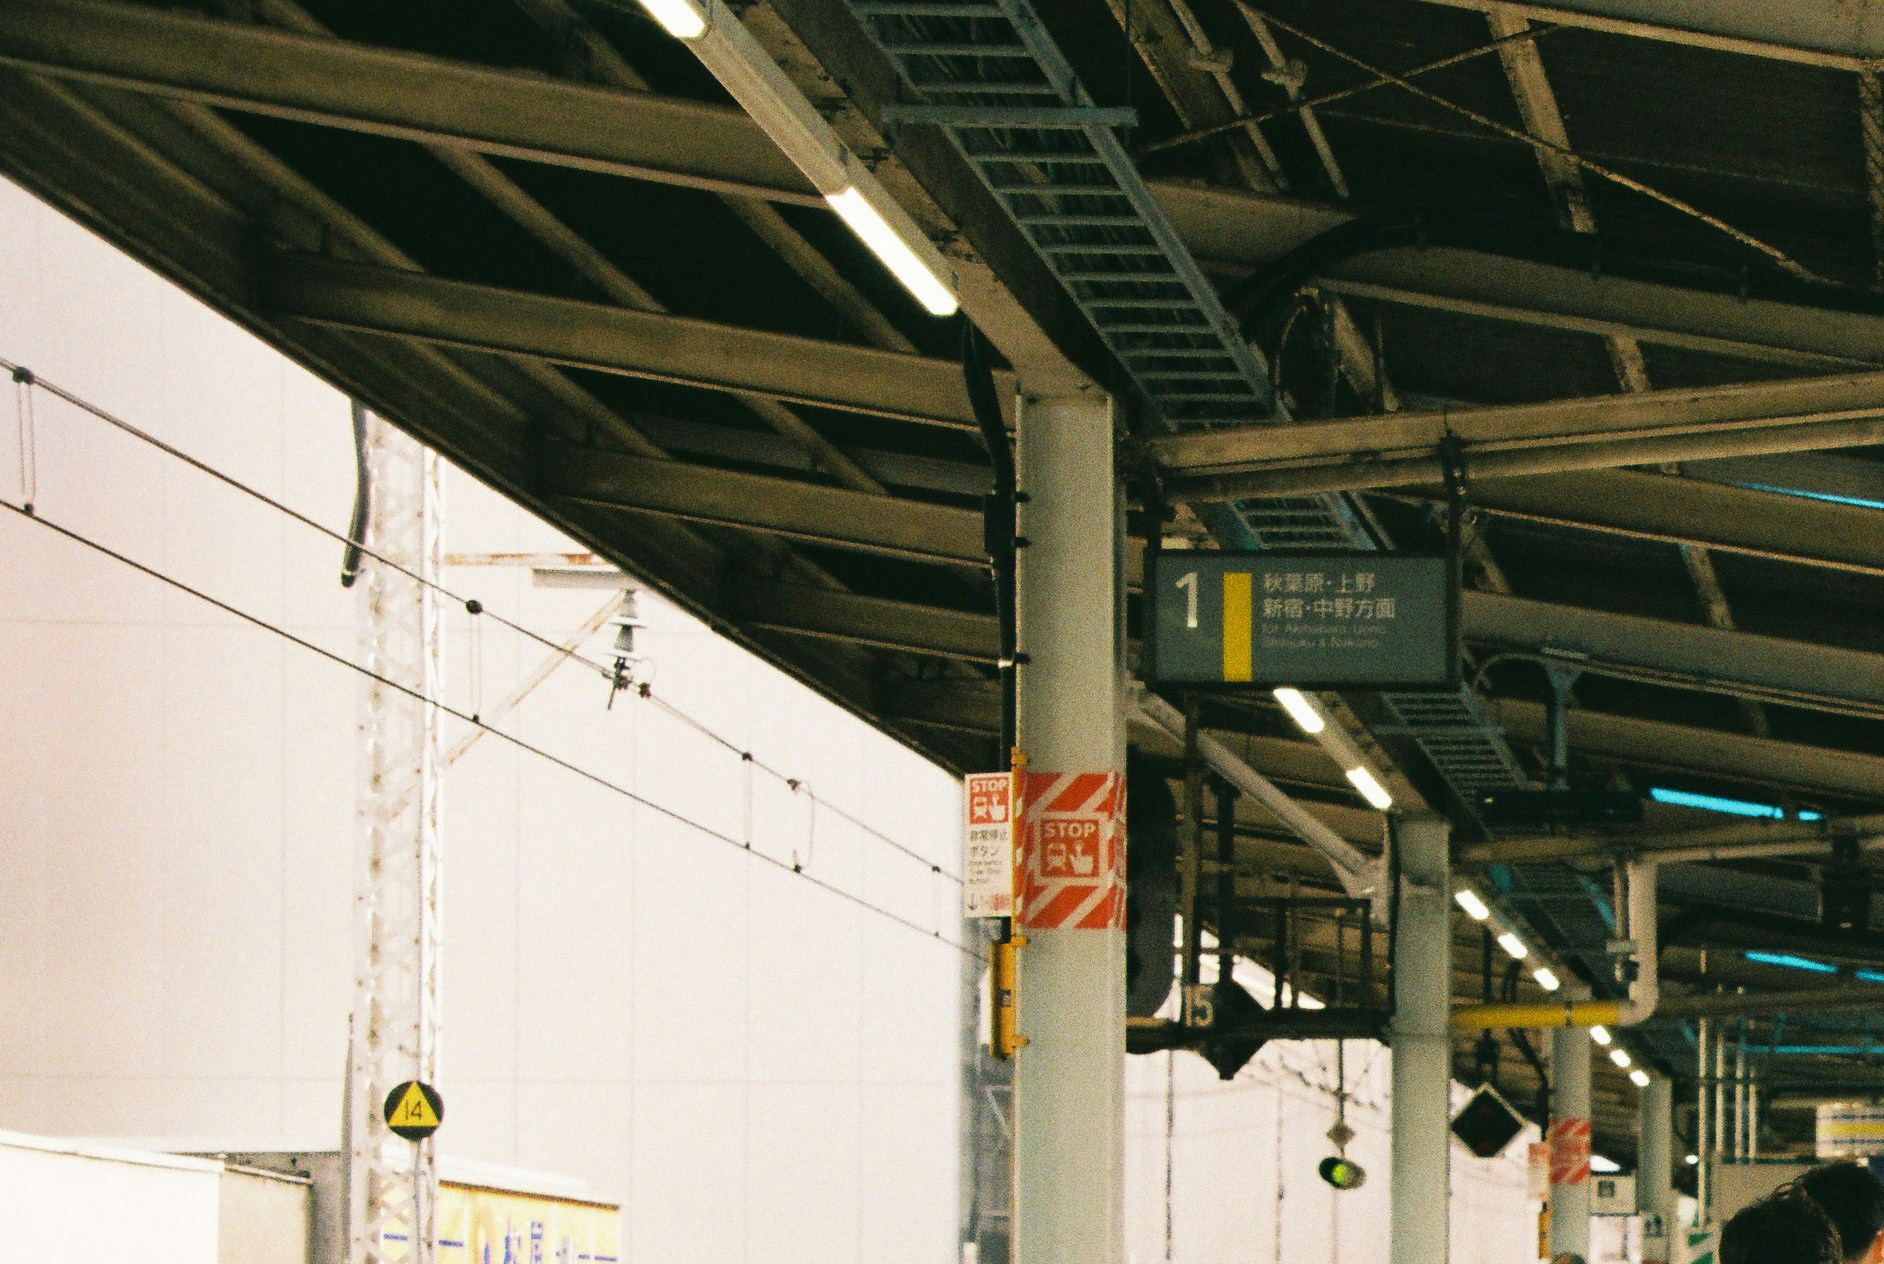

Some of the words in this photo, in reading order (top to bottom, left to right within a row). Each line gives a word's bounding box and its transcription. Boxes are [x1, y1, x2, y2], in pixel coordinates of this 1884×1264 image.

[1175, 572, 1198, 628] 1
[971, 780, 1007, 793] STOP
[1044, 822, 1096, 838] STOP
[1184, 985, 1214, 1028] 15
[404, 1100, 422, 1120] 14
